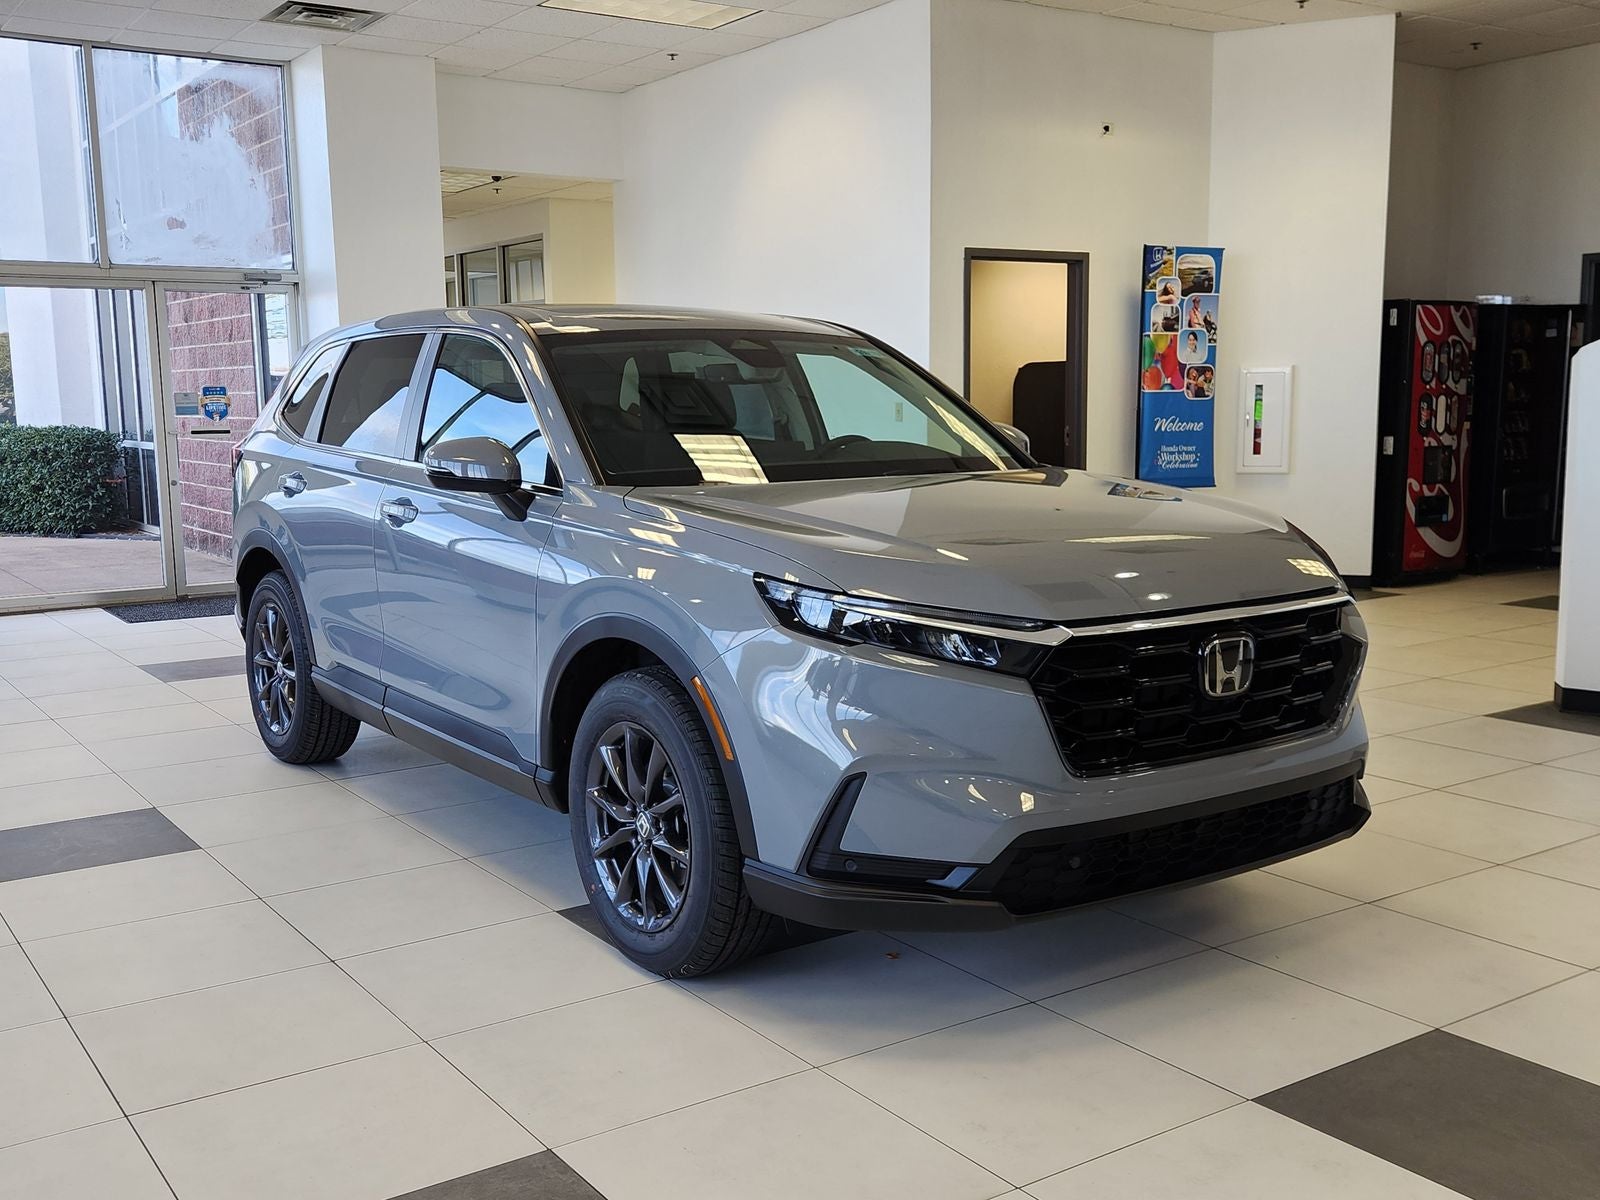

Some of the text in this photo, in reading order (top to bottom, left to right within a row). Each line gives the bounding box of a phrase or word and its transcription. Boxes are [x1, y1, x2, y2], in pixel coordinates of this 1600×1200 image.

[1154, 416, 1204, 432] Welcome
[1161, 452, 1196, 462] Workshop
[1162, 461, 1198, 469] Celebration
